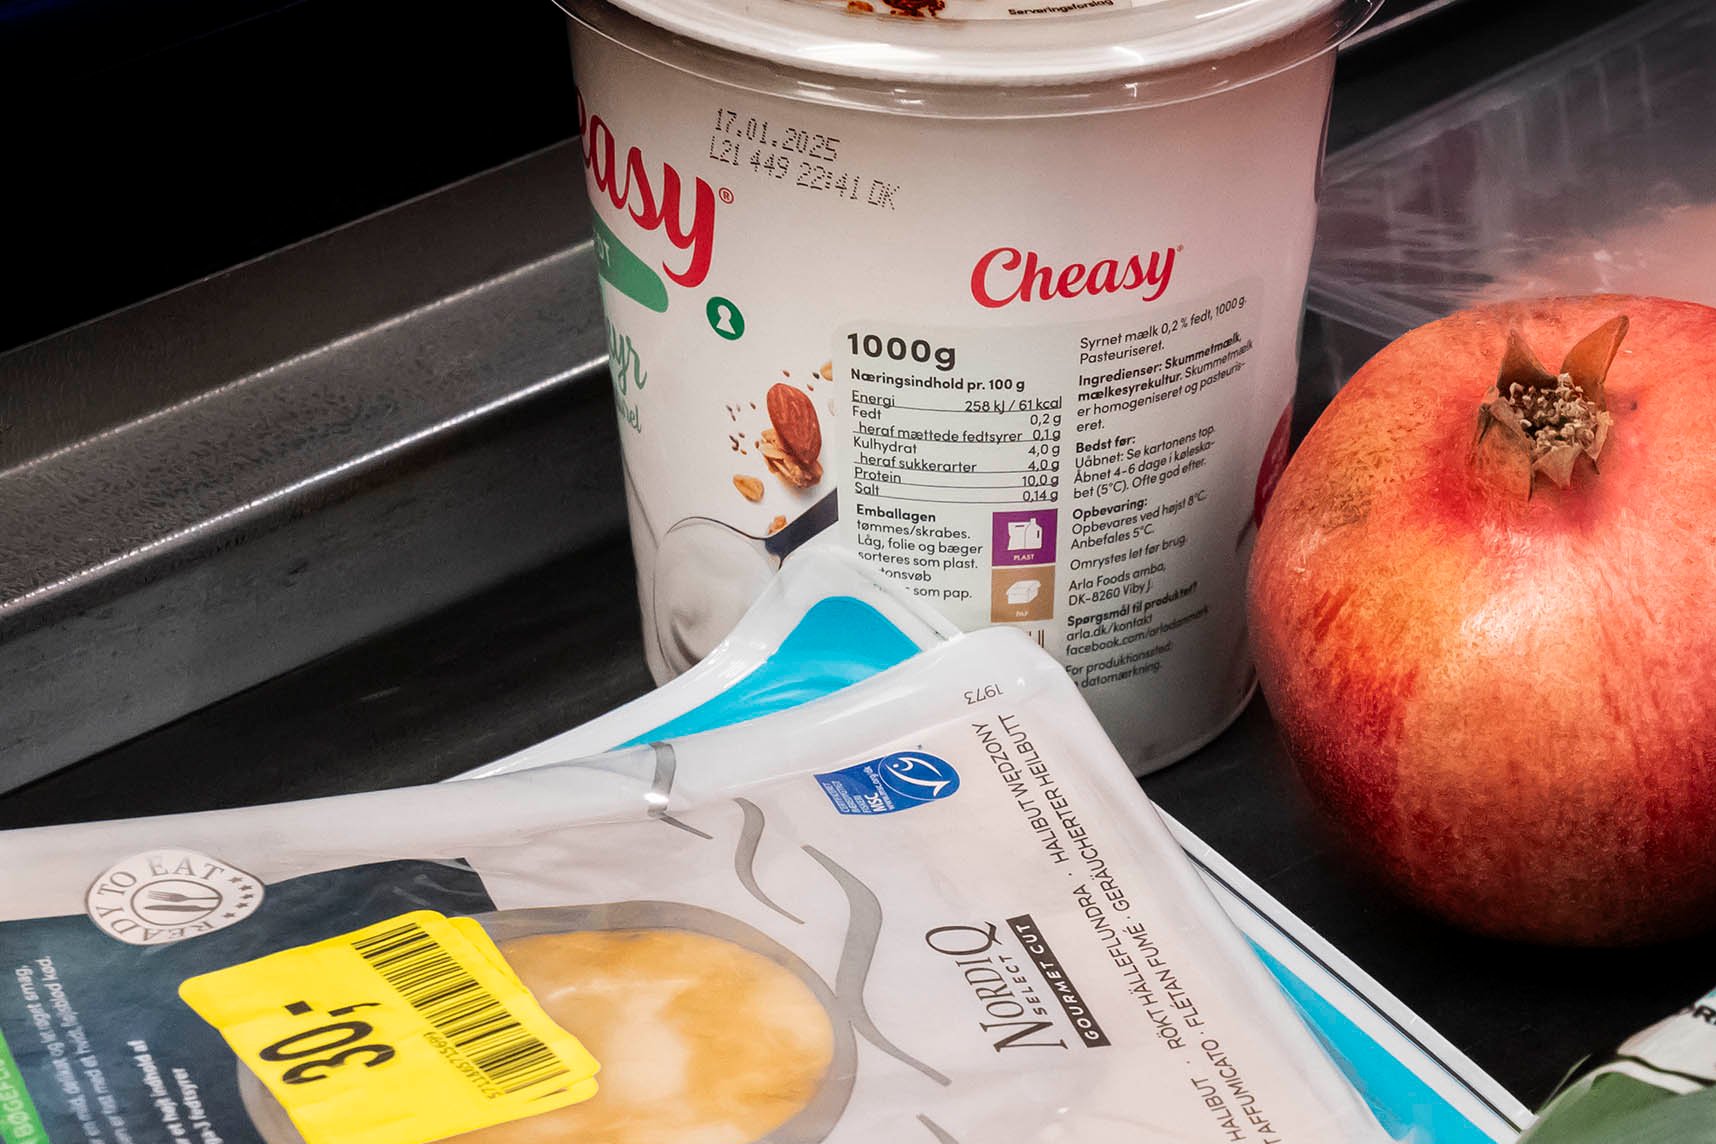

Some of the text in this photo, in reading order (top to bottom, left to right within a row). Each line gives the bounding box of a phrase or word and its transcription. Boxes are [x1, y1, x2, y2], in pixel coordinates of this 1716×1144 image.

[715, 108, 841, 162] 17.01.2025
[750, 150, 791, 179] 449
[867, 178, 901, 211] DK
[970, 247, 1176, 309] Cheasy
[1080, 332, 1122, 351] Syrnet
[1125, 328, 1159, 343] mælk
[1161, 320, 1179, 335] 0,2
[1181, 318, 1188, 329] %
[1190, 310, 1213, 327] fedt,
[1215, 297, 1238, 316] 1000
[847, 332, 957, 372] 1000g
[1079, 331, 1242, 389] Ingredienser: Skummetmælk,
[1080, 340, 1165, 365] Pasteuriseret.
[851, 368, 1025, 393] Næringsindhold pr. 100 g
[1077, 339, 1253, 402] mælkesyrekultur. Skummetmælk
[852, 390, 895, 408] Energi
[965, 400, 990, 412] 258
[1019, 399, 1033, 410] 61
[1036, 396, 1062, 410] kcal
[1077, 362, 1246, 417] er homogeniseret og pasteuris-
[852, 406, 1062, 427] Fedt 0,2 g
[859, 422, 1061, 444] heraf mættede fedtsyrer 0,1 g
[1076, 420, 1105, 433] eret.
[853, 437, 1061, 457] Kulhydrat 4,0 g
[860, 452, 1060, 473] heraf sukkerarter 4,0 g
[1073, 468, 1112, 485] Åbnet
[1113, 461, 1136, 476] 4-6
[1138, 455, 1166, 474] dage
[1174, 440, 1216, 462] køleska-
[1075, 424, 1216, 470] Uåbnet: Se kartonens top.
[1076, 435, 1136, 454] Bedst før:
[855, 467, 1059, 487] Protein 10,0 g
[855, 482, 1059, 503] Salt 0,14 g
[1074, 458, 1207, 499] bet (5°C). Ofte god efter.
[856, 504, 936, 524] Emballagen
[1072, 498, 1149, 521] Opbevaring:
[1072, 500, 1186, 536] Opbevares ved højst
[857, 519, 971, 540] tømmes/skrabes.
[858, 533, 984, 557] Låg, folie og bæger
[1071, 529, 1131, 550] Anbefales
[859, 550, 978, 571] sorteres som plast.
[1068, 562, 1166, 592] Arla Foods amba,
[1070, 551, 1128, 572] Omrystes
[1128, 546, 1144, 558] let
[913, 586, 972, 601] som pap.
[1068, 581, 1144, 606] DK-8260 Viby
[1066, 614, 1153, 641] arla.dk/kontakt
[1067, 601, 1143, 628] Spørgsmål til
[963, 682, 1005, 705] 1973
[972, 722, 1028, 798] WĘDZONY
[997, 714, 1055, 787] HEILBUTT
[1018, 799, 1069, 864] HALIBUT
[1045, 786, 1130, 912] GERÄUCHERTER
[95, 854, 225, 941] READY TO EAT
[1072, 883, 1159, 1007] HÄLLEFLUNDRA
[1122, 922, 1167, 968] FUMÉ
[15, 964, 39, 1001] smag,
[35, 956, 58, 981] kød.
[998, 954, 1048, 1016] SELECT
[1015, 924, 1100, 1041] GOURMET CUT
[1155, 969, 1205, 1028] FLÉTAN
[259, 1000, 396, 1085] 30,-
[1146, 1009, 1186, 1049] RÖKT
[1201, 1039, 1277, 1134] AFFUMICATO
[1190, 1077, 1247, 1142] HALIBUT
